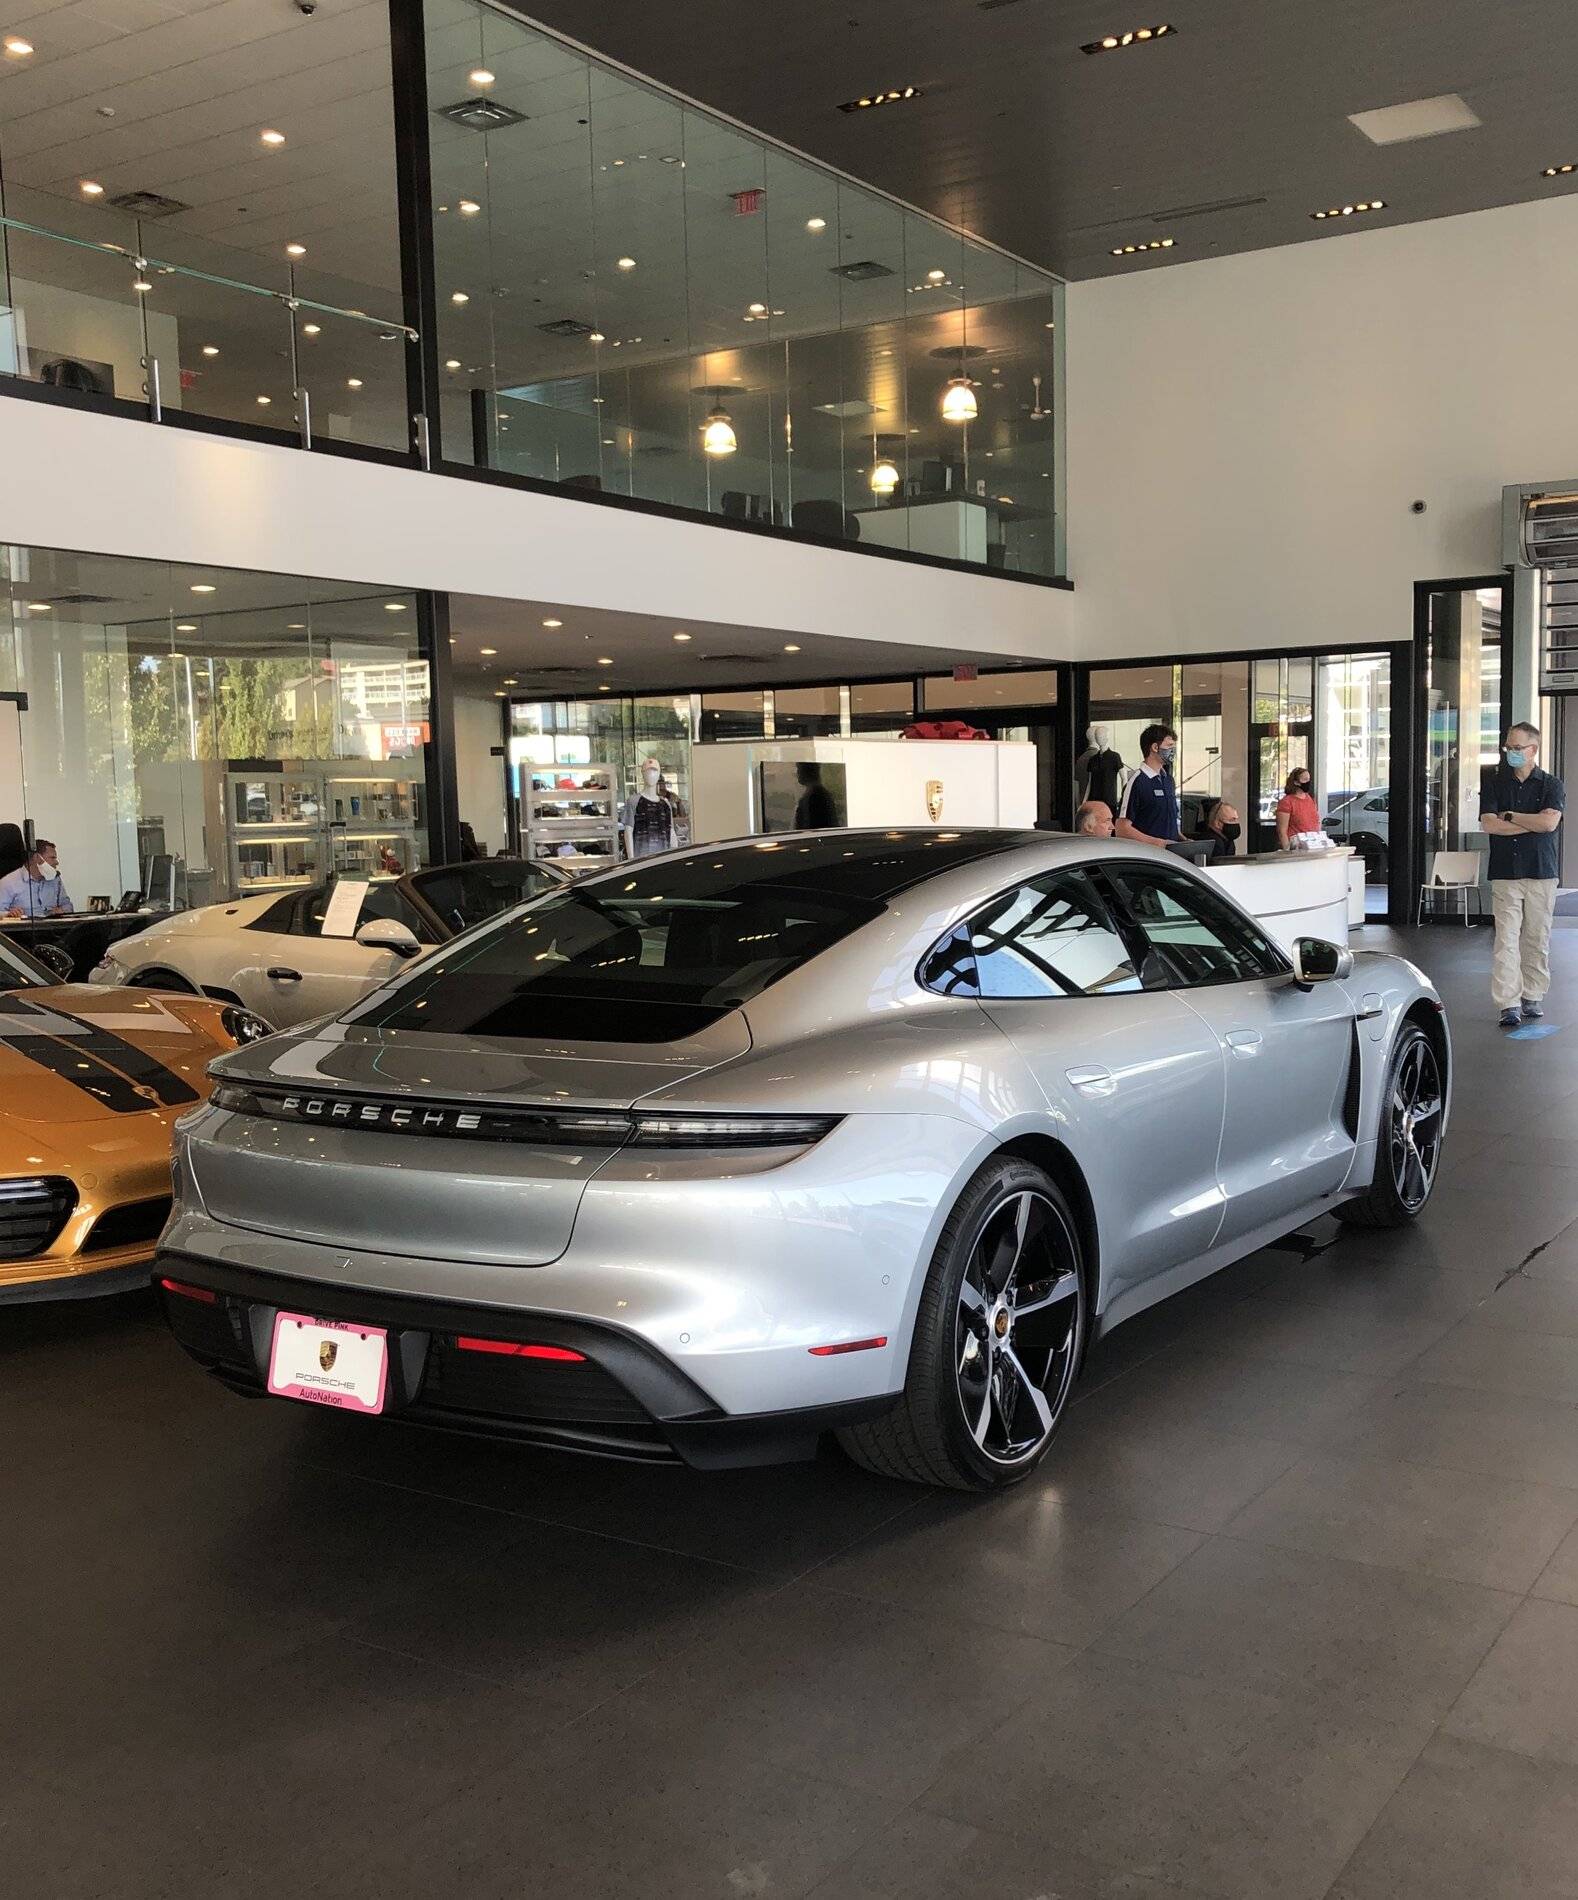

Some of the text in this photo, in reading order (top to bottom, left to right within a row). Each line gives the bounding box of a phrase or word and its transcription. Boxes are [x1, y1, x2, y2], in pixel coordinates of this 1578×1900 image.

[282, 1097, 482, 1129] PORSCHE
[296, 1373, 355, 1389] PORSCHE
[299, 1389, 342, 1405] AutoNation
